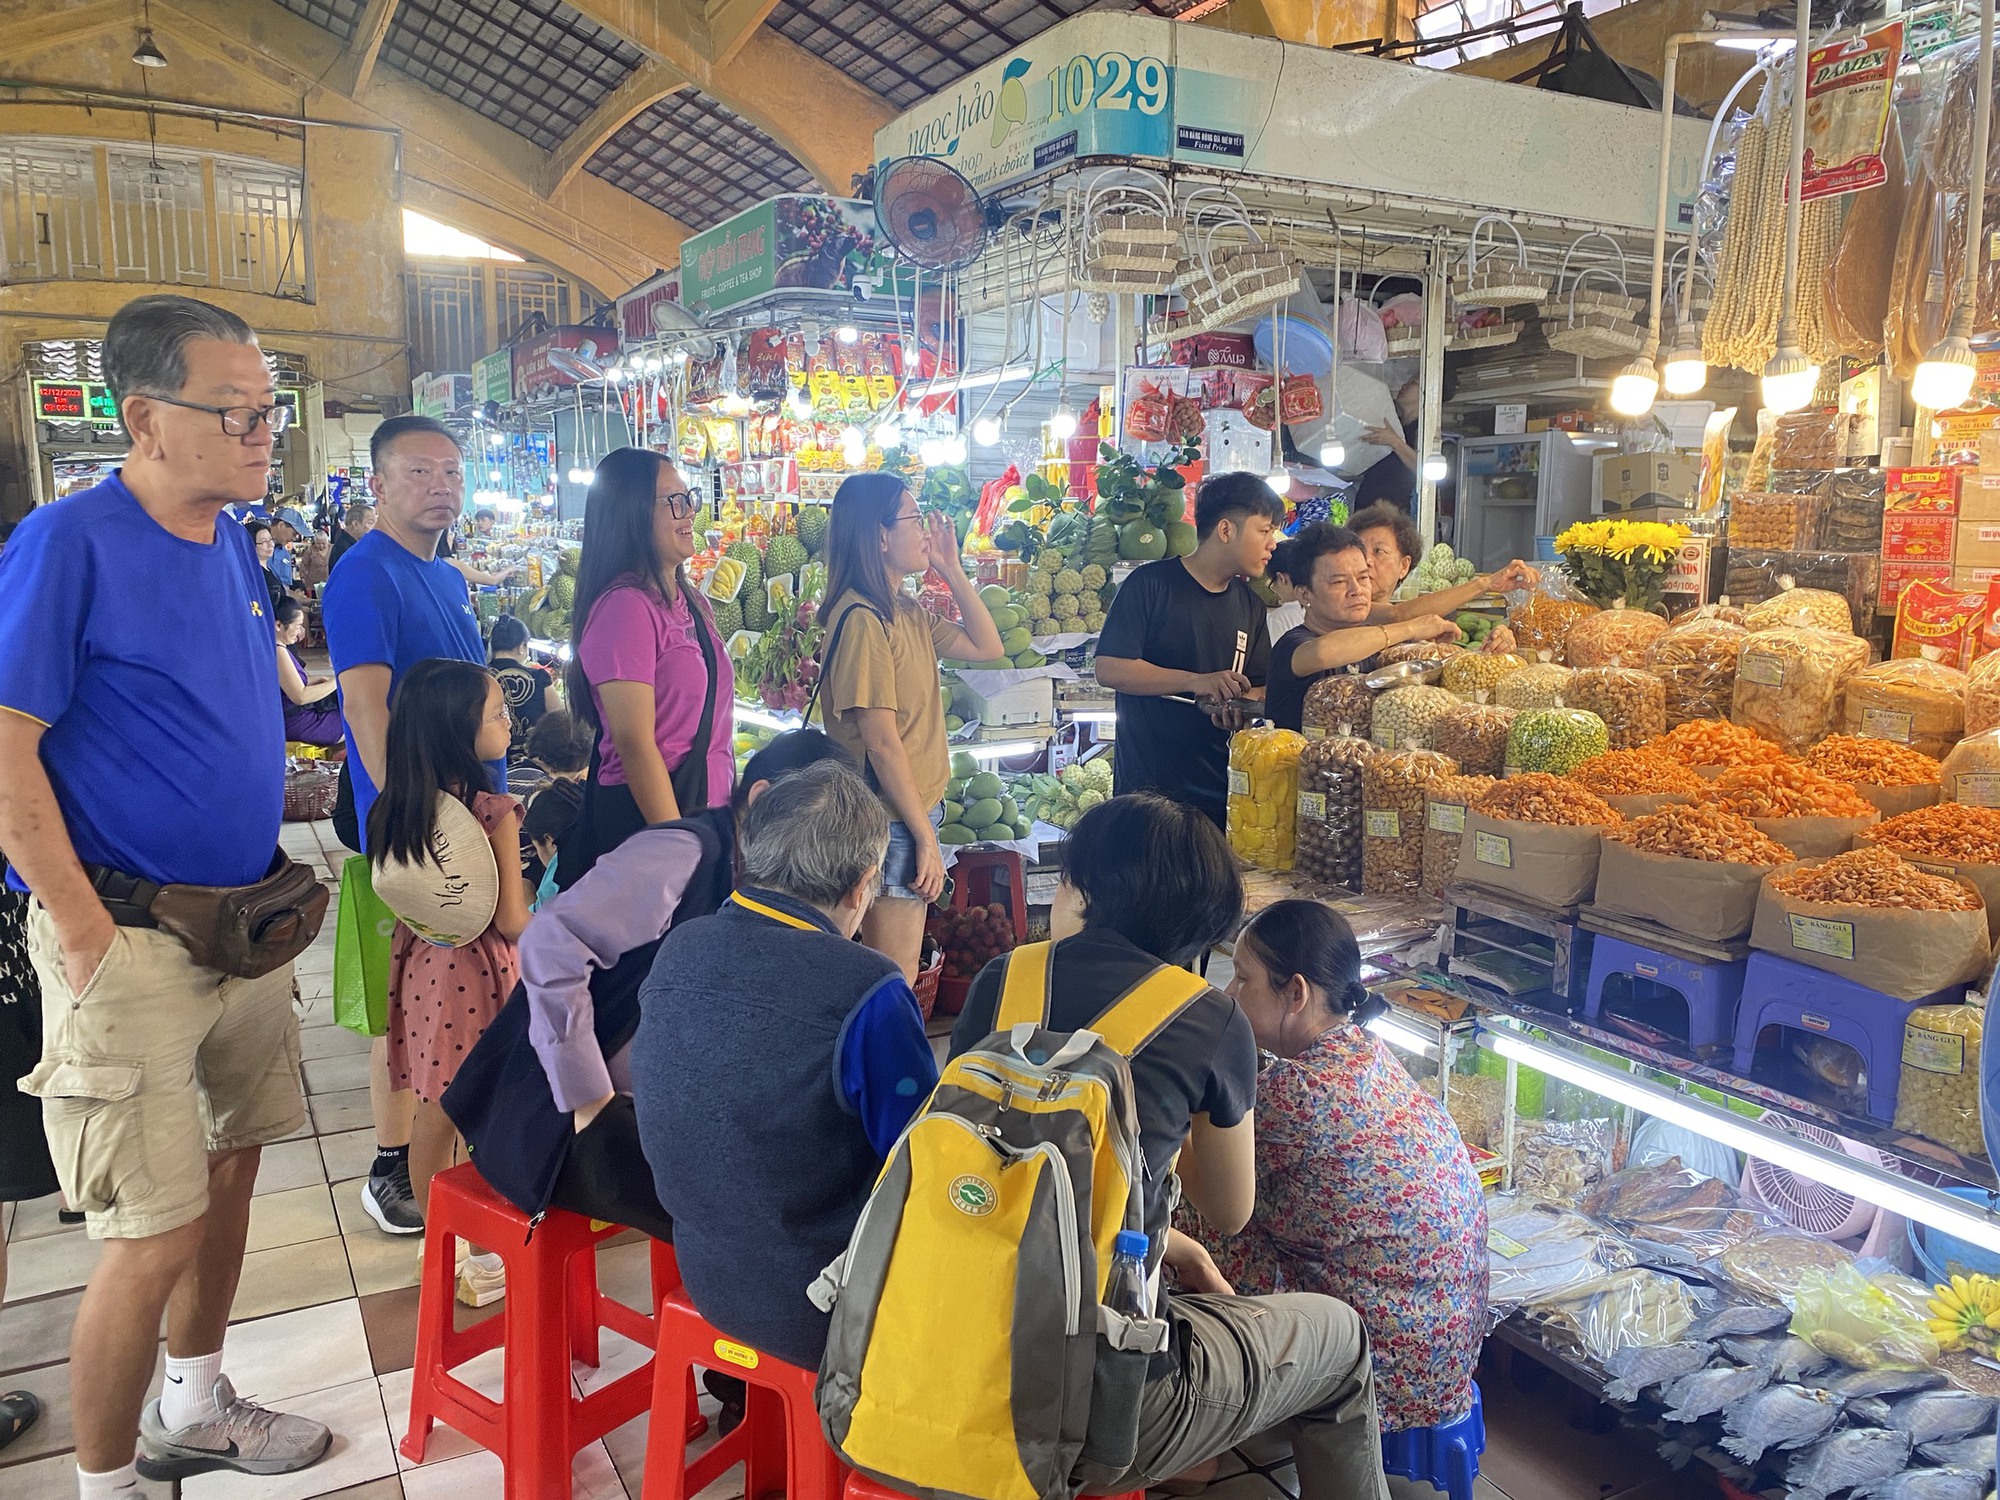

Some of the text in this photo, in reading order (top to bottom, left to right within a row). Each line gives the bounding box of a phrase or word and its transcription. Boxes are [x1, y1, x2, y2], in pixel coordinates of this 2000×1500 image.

[1047, 51, 1169, 124] 1029
[956, 82, 994, 135] hảo
[1194, 140, 1228, 152] Fixed Price
[1000, 151, 1030, 176] choice
[701, 285, 716, 300] FRUITS
[718, 277, 735, 293] COFFEE
[739, 272, 749, 285] TEA
[748, 266, 763, 281] SHOP
[1219, 346, 1246, 365] envy
[1810, 920, 1848, 932] BẢNG GIÁ
[1917, 1030, 1957, 1045] BẢNG GIÁ
